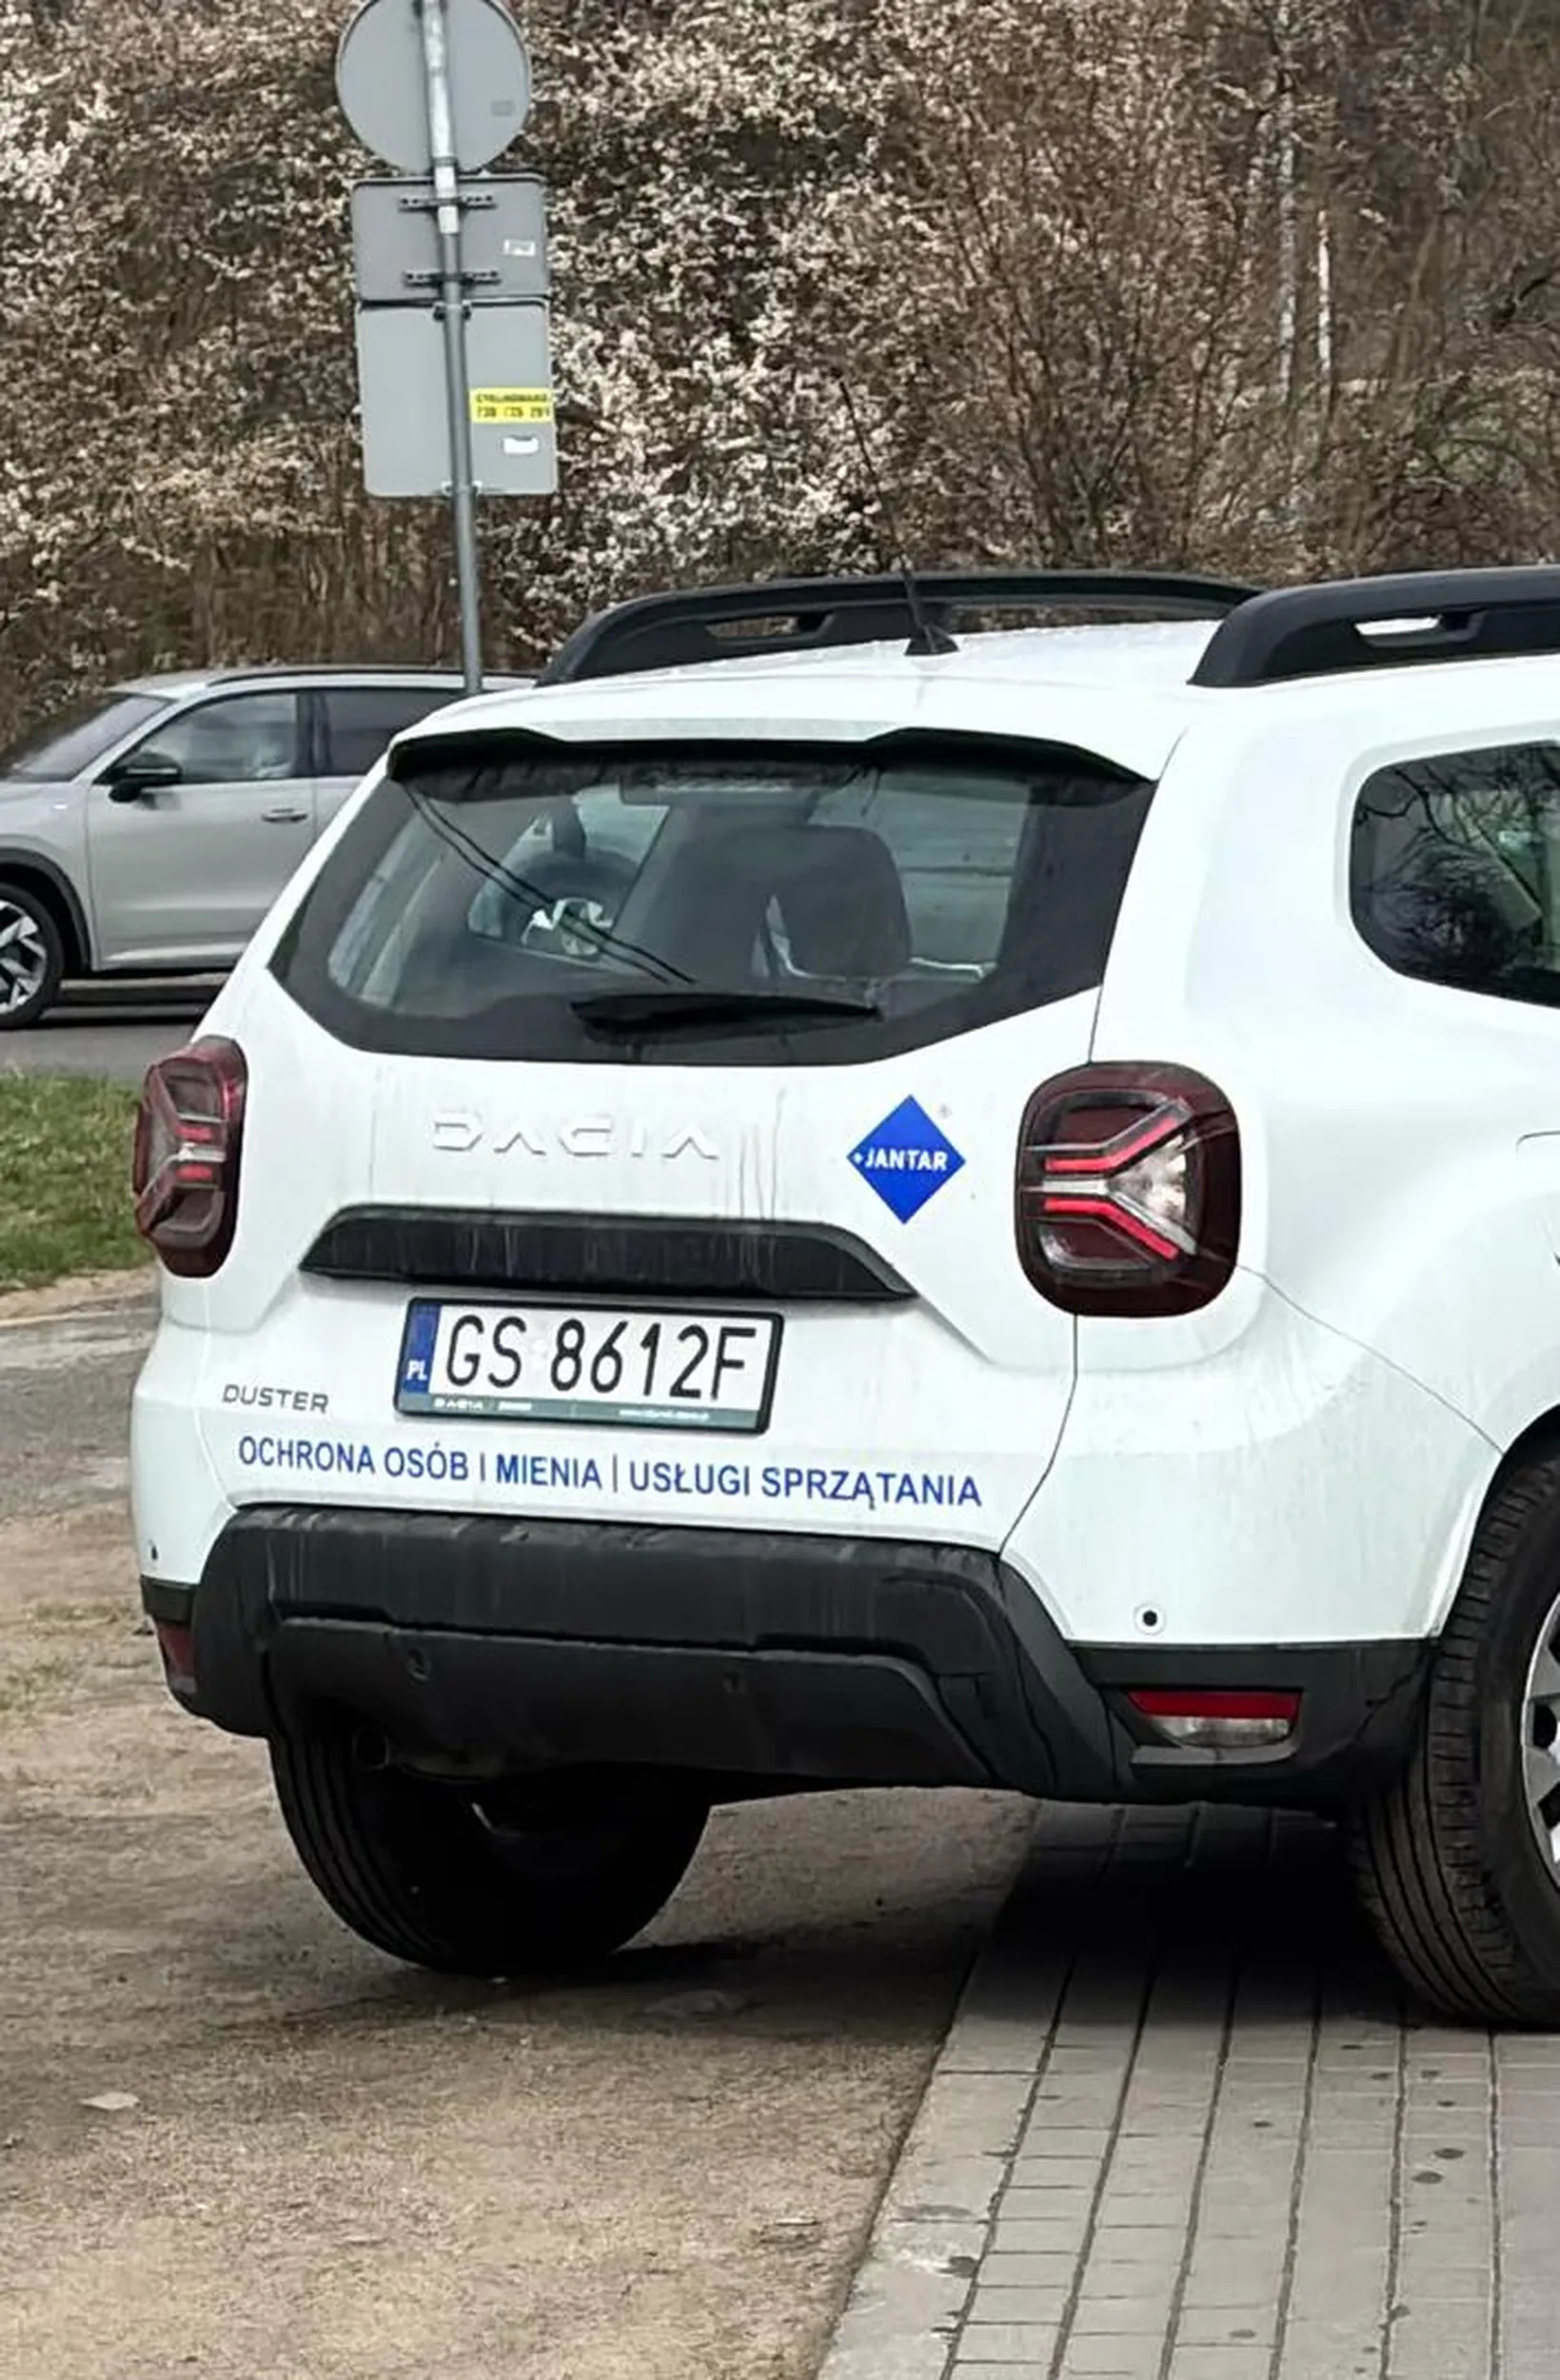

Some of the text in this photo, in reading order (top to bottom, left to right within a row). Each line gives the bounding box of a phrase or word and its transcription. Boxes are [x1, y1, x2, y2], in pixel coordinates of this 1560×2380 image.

[430, 1111, 720, 1160] DACIA
[864, 1147, 949, 1172] JANTAR
[405, 1359, 428, 1382] PL
[446, 1314, 758, 1401] GS 8612F
[222, 1383, 329, 1414] DUSTER
[238, 1436, 376, 1475] OCHRONA
[384, 1441, 470, 1481] OSÓB
[496, 1453, 602, 1490] MIENIA
[629, 1459, 750, 1497] USŁUGI
[761, 1466, 982, 1511] SPRZĄTANIA
